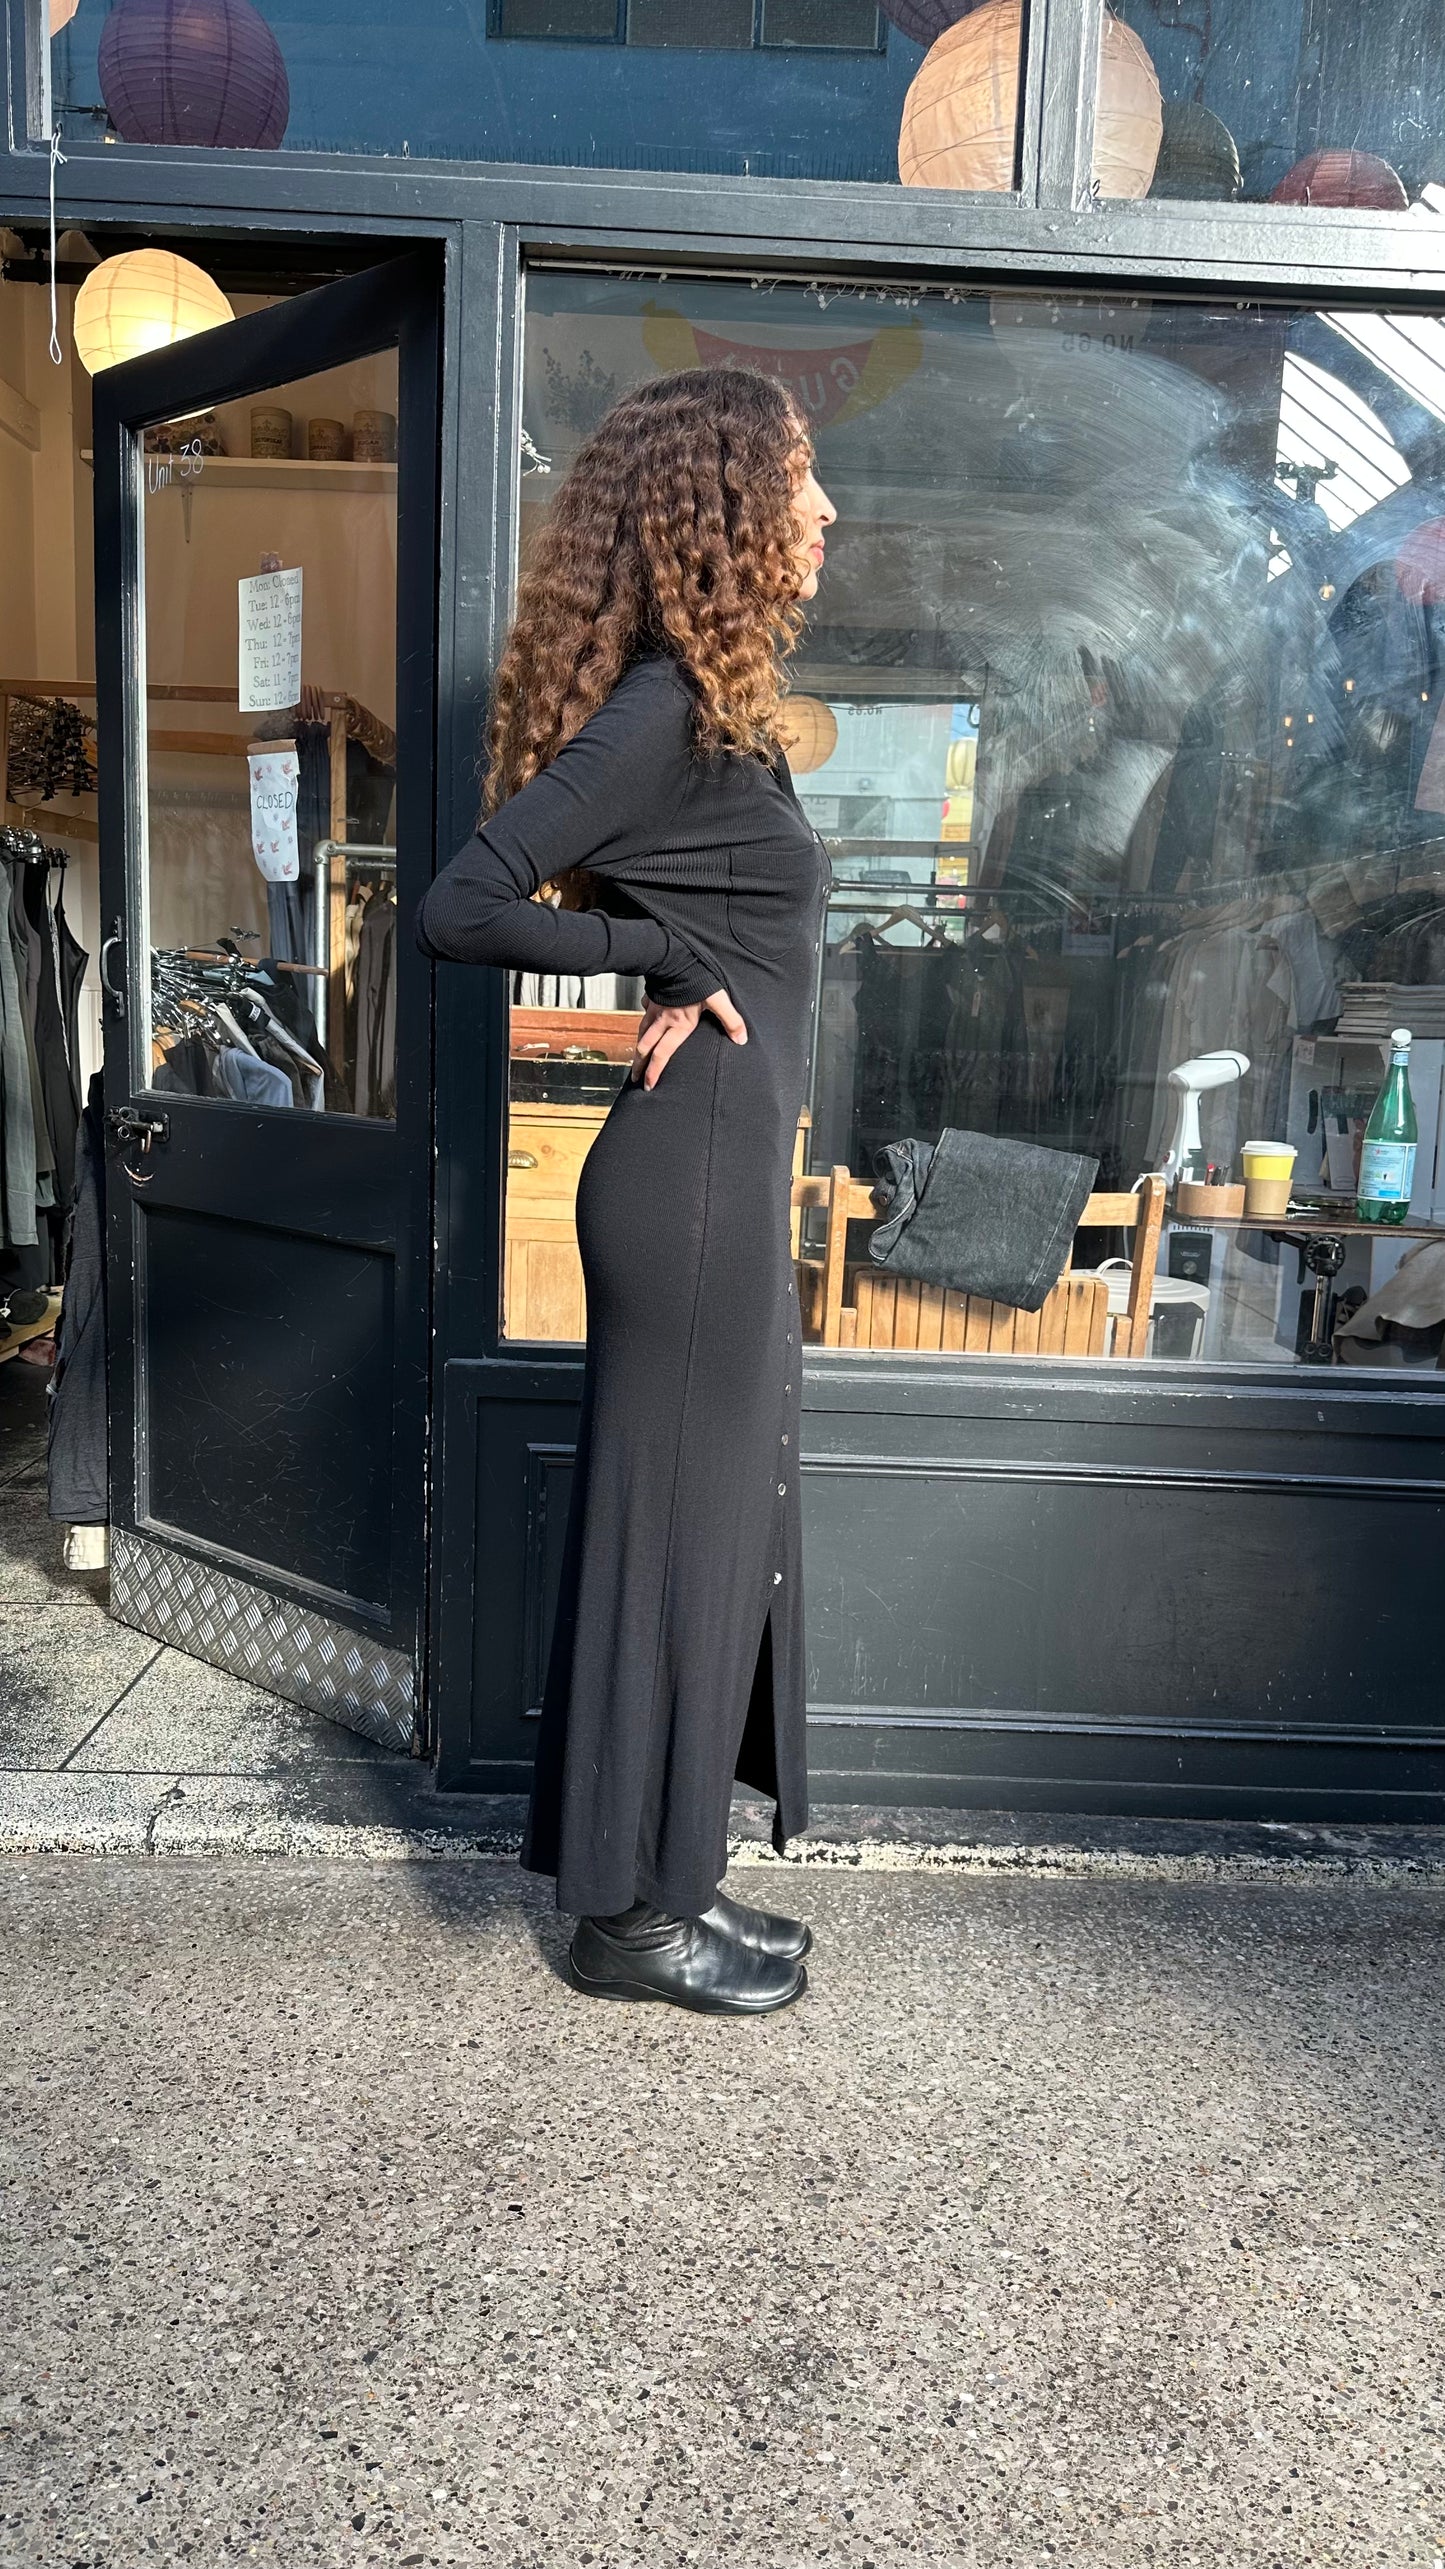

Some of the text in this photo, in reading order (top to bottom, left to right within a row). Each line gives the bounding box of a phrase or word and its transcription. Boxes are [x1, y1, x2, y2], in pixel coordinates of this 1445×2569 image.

[149, 438, 204, 494] Unit 38
[249, 574, 299, 594] Mon: Closed
[248, 600, 268, 612] Tue:
[247, 618, 271, 631] Wed:
[244, 638, 268, 651] Thu:
[253, 656, 269, 669] Fri:
[253, 675, 271, 688] Sat:
[248, 694, 271, 707] Sun:
[256, 791, 293, 809] CLOSED
